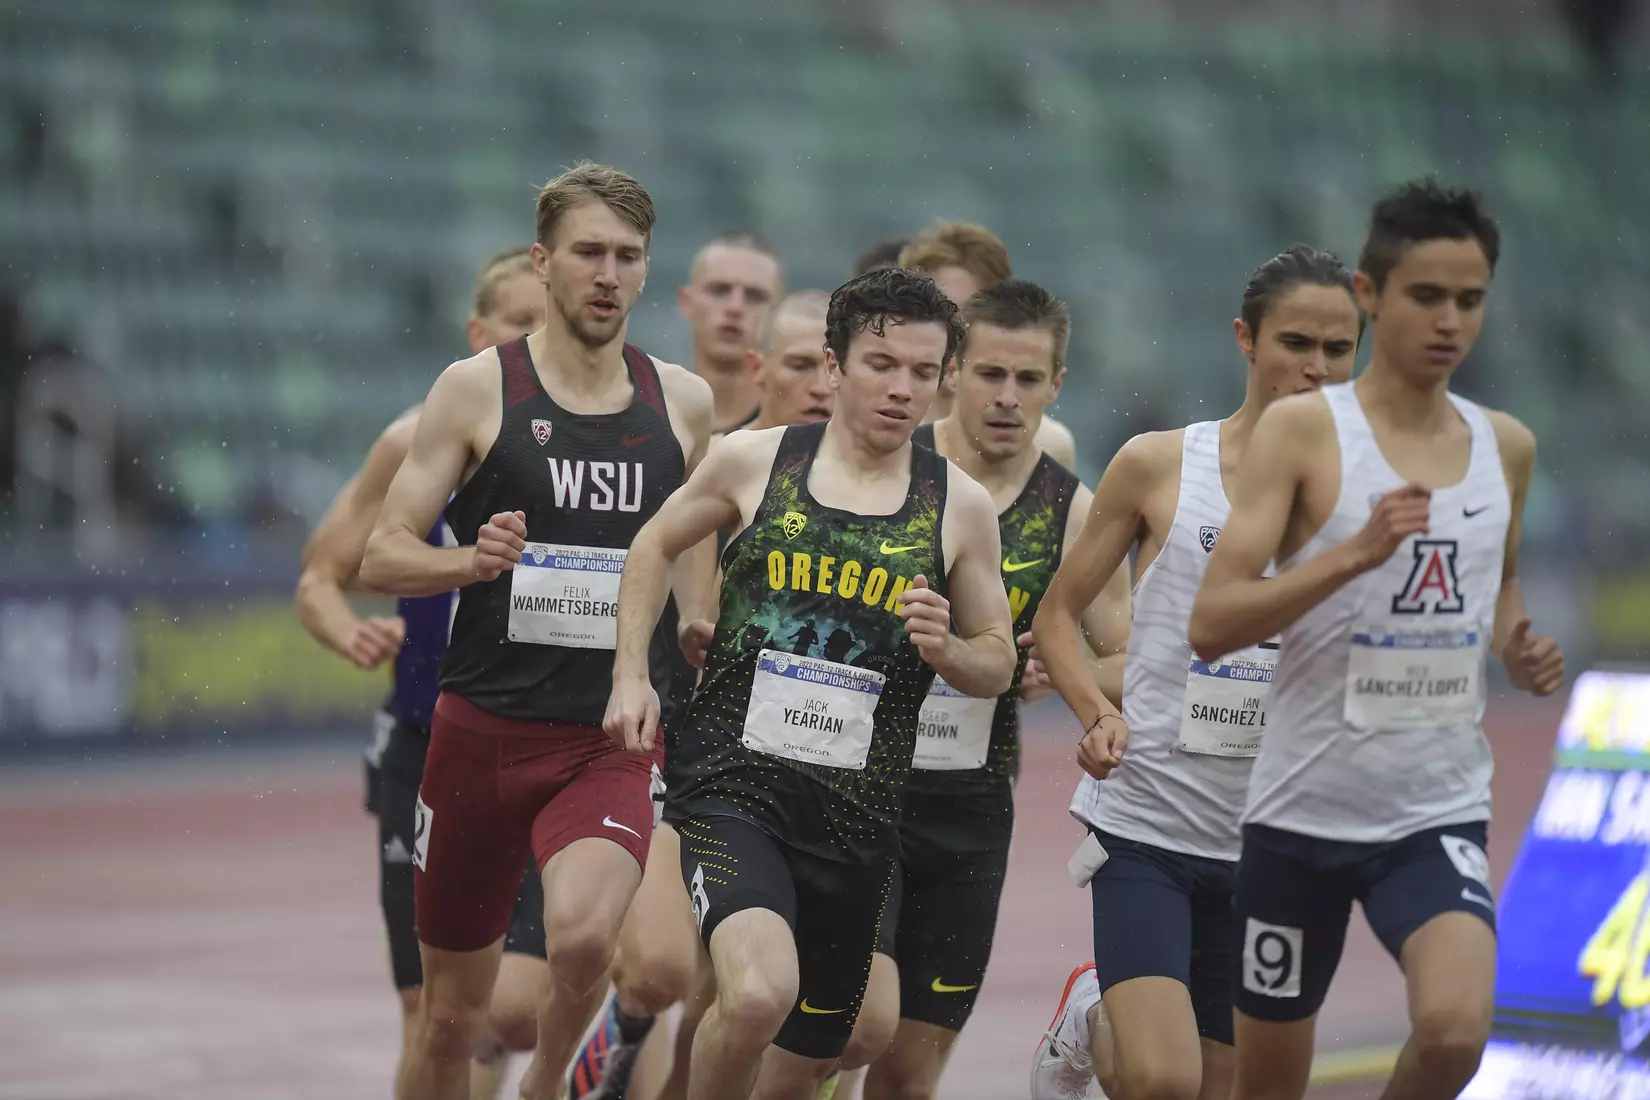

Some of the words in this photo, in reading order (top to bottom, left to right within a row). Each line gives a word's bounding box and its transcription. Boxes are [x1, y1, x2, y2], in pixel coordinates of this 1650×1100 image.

[537, 430, 546, 440] 12
[547, 457, 643, 512] WSU
[786, 523, 798, 535] 12
[1203, 537, 1215, 548] 12
[556, 549, 569, 557] 2022
[570, 550, 591, 558] PAC-12
[591, 551, 608, 560] TRACK
[767, 550, 914, 618] OREGON
[1391, 540, 1464, 615] A
[563, 586, 591, 599] FELIX
[798, 659, 813, 668] 2022
[813, 662, 834, 672] PAC-12
[835, 667, 852, 676] TRACK
[859, 672, 874, 681] FIELD
[1230, 659, 1245, 667] 2022
[797, 668, 871, 692] CHAMPIONSHIPS
[803, 698, 829, 714] JACK
[1242, 697, 1260, 709] IAN
[784, 708, 844, 734] YEARIAN
[1191, 703, 1256, 726] SANCHEZ
[1254, 931, 1292, 990] 9
